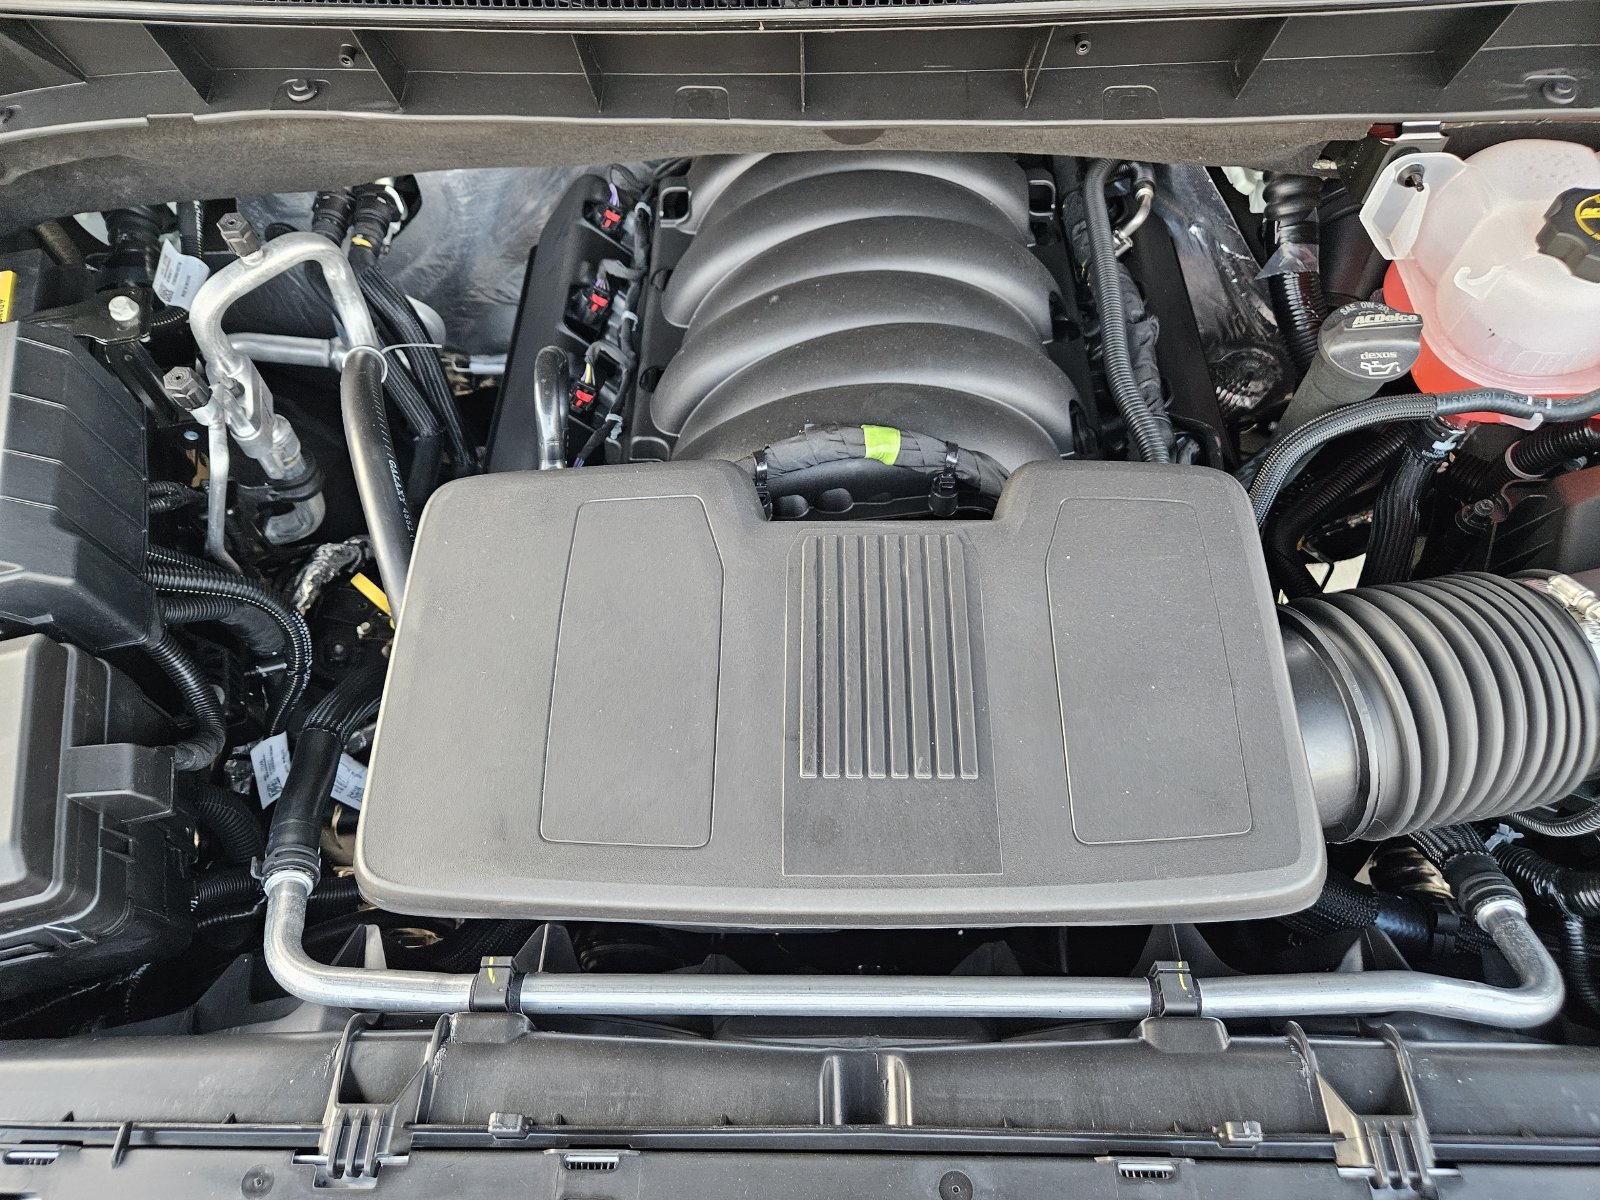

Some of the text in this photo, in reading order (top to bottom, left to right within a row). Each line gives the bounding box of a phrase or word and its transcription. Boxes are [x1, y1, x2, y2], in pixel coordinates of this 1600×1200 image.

[1340, 302, 1358, 316] SAE
[1352, 312, 1418, 326] ACDelco
[1360, 351, 1398, 360] dexos
[388, 459, 407, 506] GALAXY
